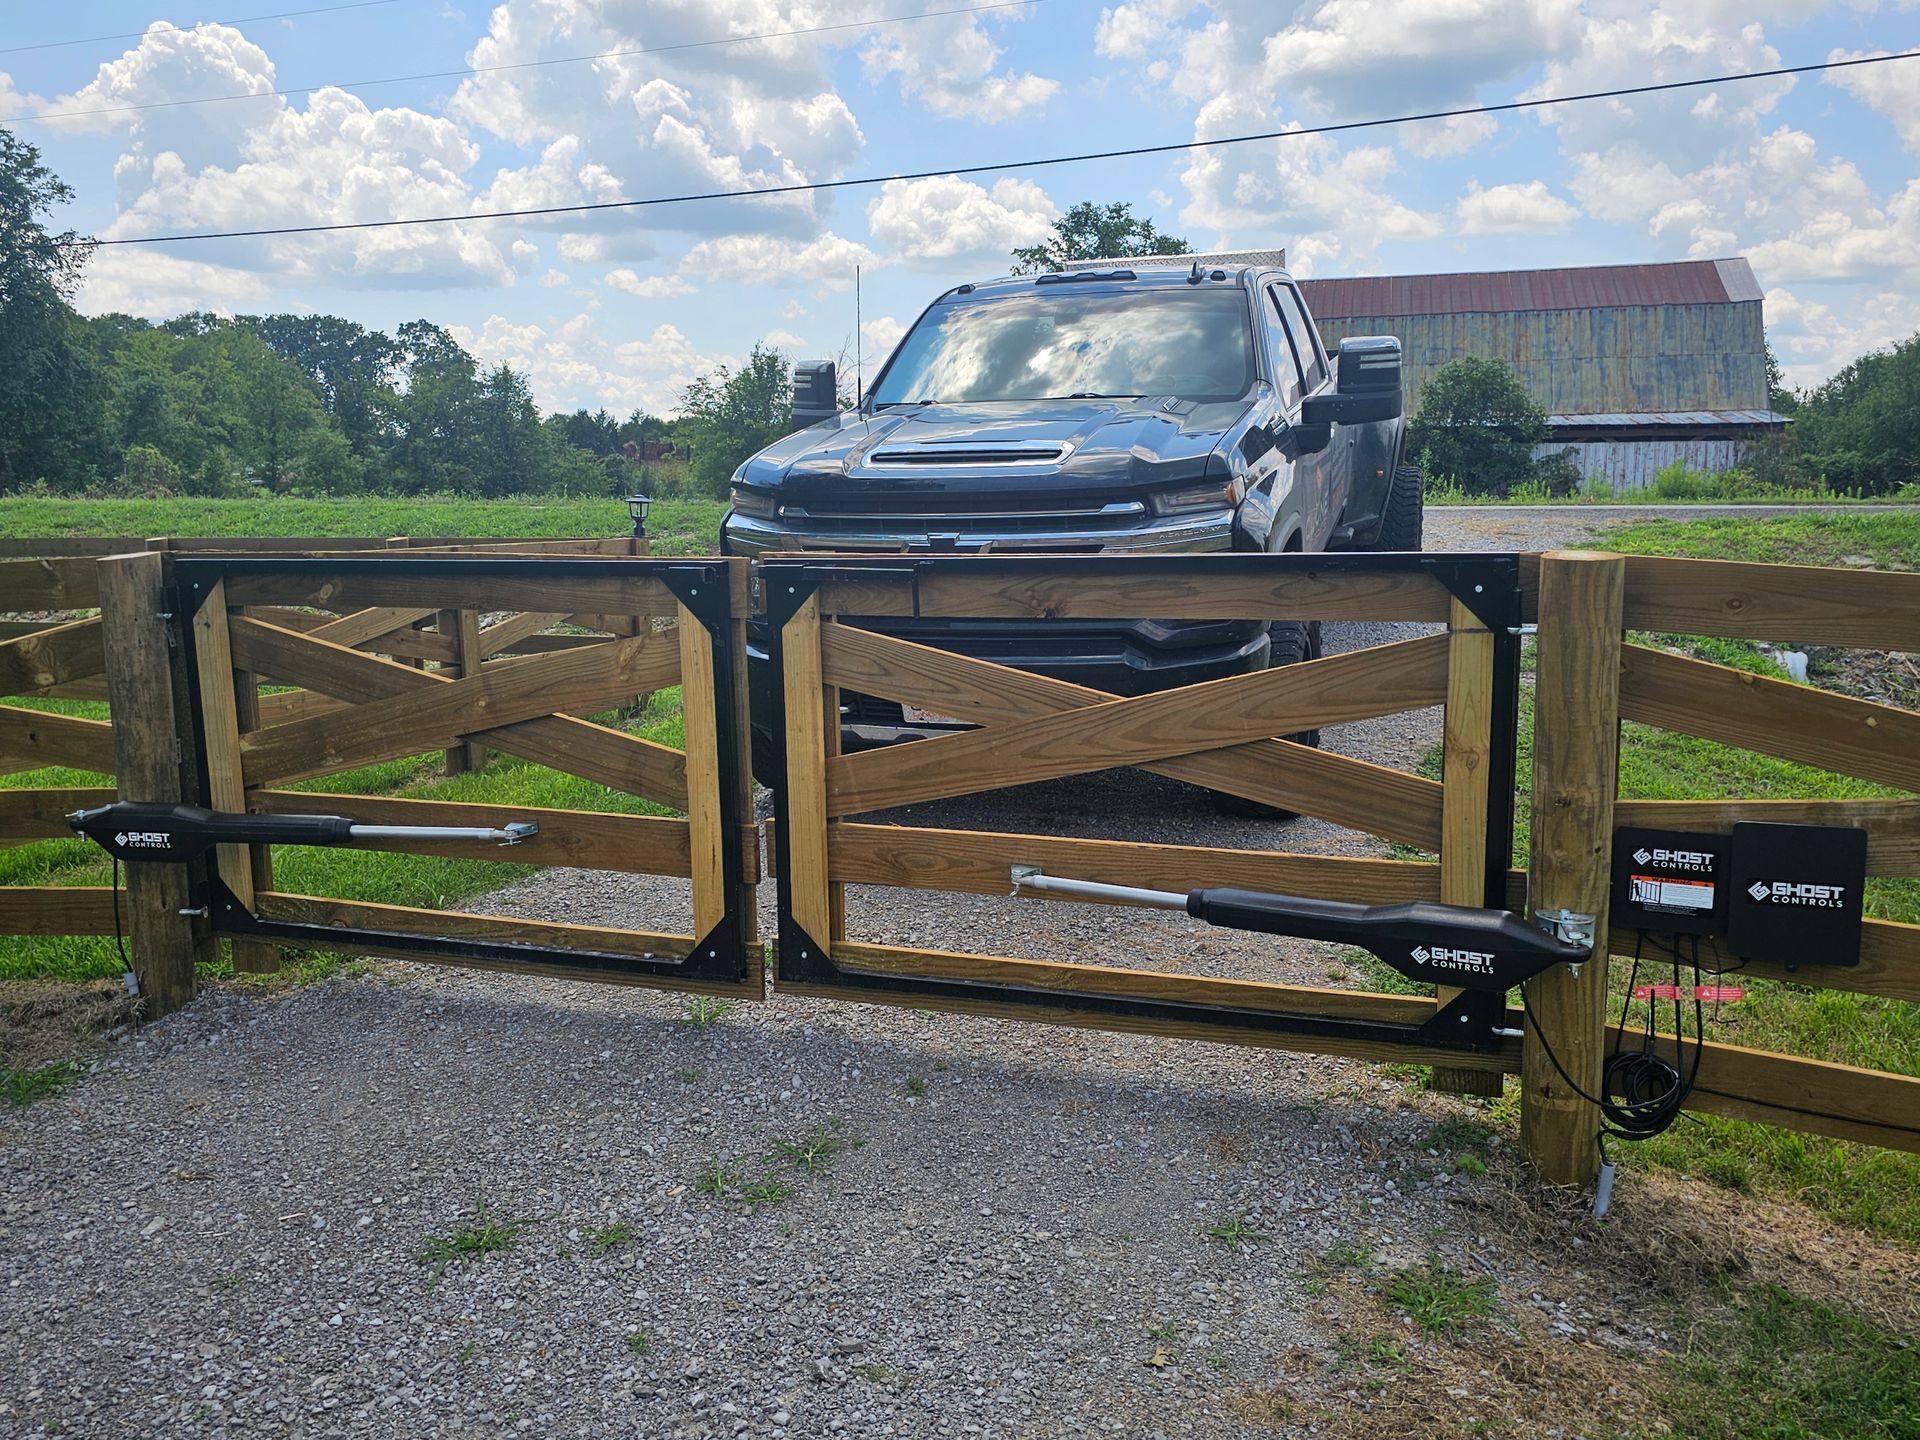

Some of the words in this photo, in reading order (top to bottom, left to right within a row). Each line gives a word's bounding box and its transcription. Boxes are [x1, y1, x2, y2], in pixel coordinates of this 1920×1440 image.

[128, 831, 171, 843] GHOST
[129, 841, 171, 849] CONTROLS
[1652, 848, 1715, 865] GHOST
[1652, 860, 1713, 872] CONTROLS
[1651, 876, 1693, 886] WARNING
[1772, 881, 1845, 899] GHOST
[1771, 895, 1844, 908] CONTROLS
[1431, 947, 1495, 966] GHOST
[1431, 959, 1495, 975] CONTROLS
